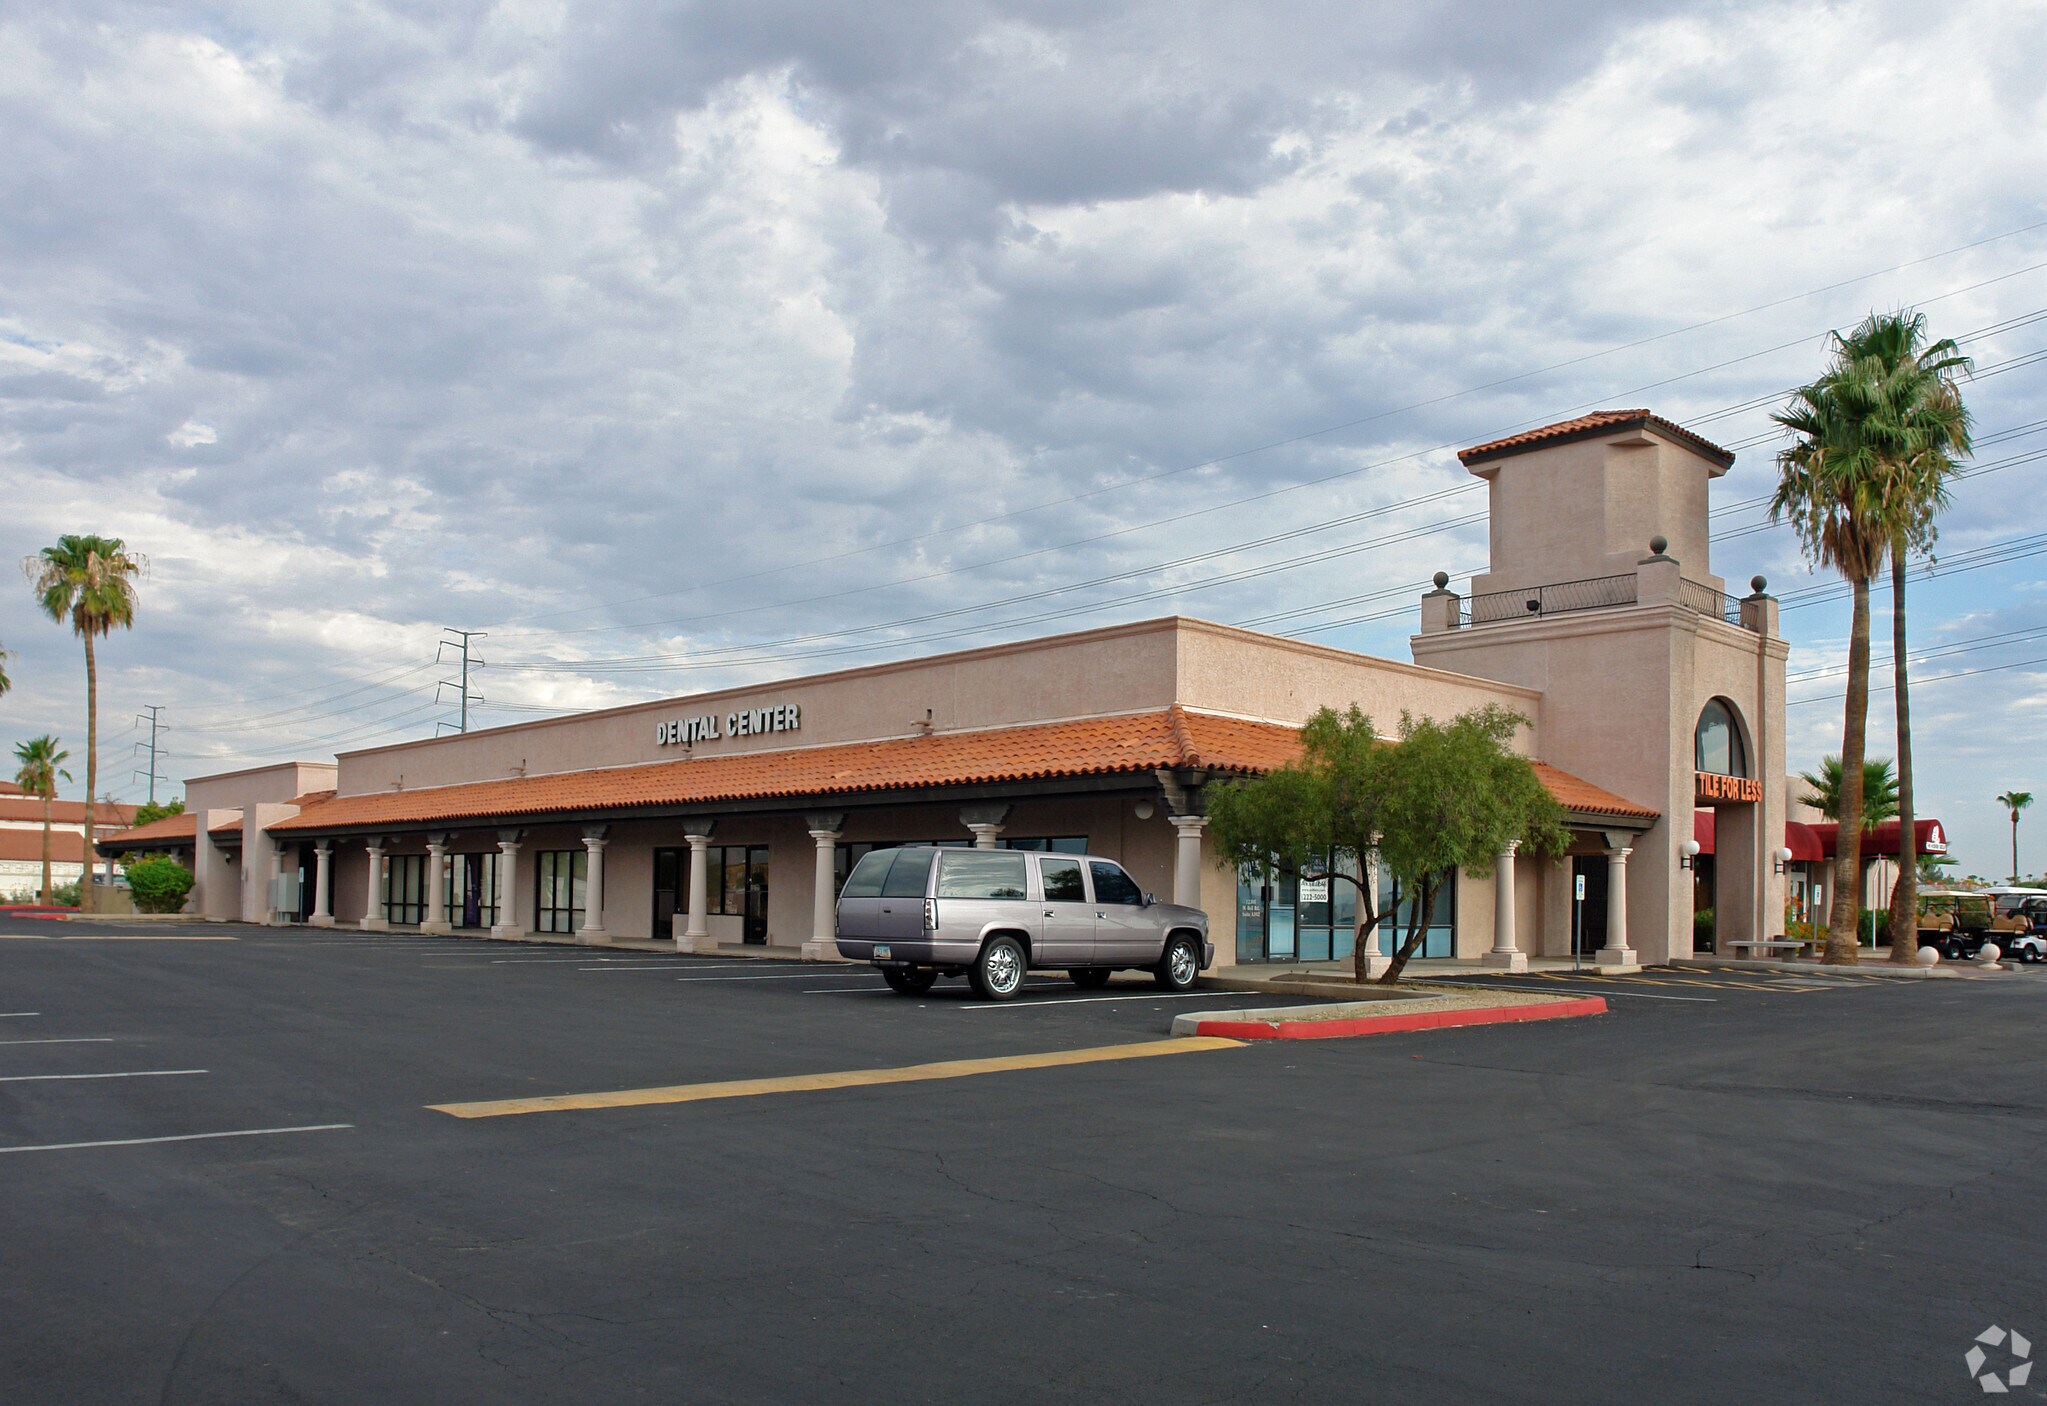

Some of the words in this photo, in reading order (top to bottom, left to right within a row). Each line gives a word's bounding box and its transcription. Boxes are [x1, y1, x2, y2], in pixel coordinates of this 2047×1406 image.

[656, 715, 720, 745] DENTAL
[725, 703, 800, 737] CENTER
[1699, 773, 1720, 798] TILE
[1721, 777, 1739, 800] FOR
[1741, 779, 1763, 802] LESS
